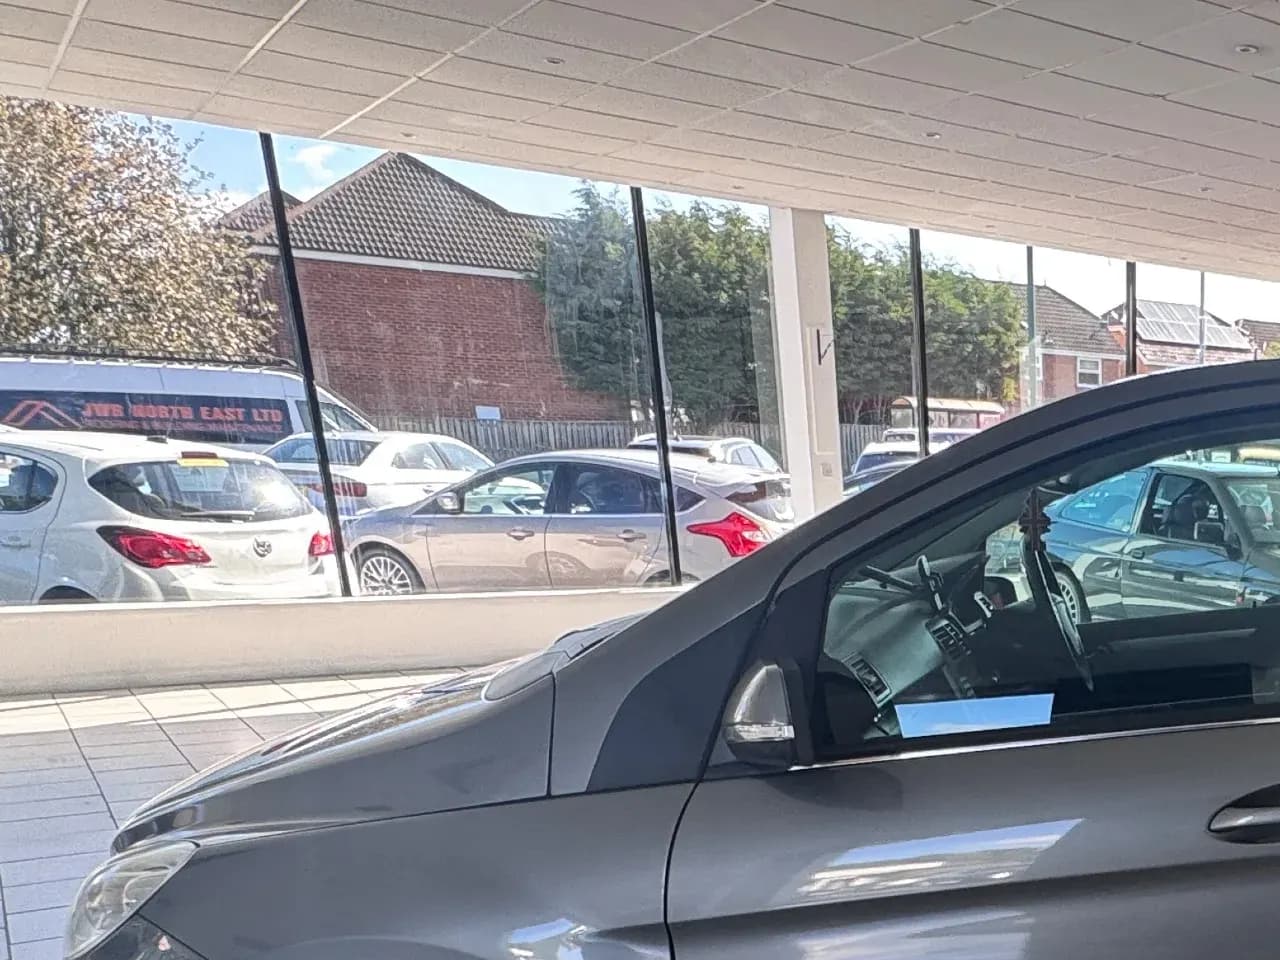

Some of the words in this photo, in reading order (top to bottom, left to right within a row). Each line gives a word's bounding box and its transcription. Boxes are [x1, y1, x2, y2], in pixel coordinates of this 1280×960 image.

[131, 405, 193, 418] NORTH
[200, 407, 246, 421] EAST
[251, 408, 283, 422] LTD
